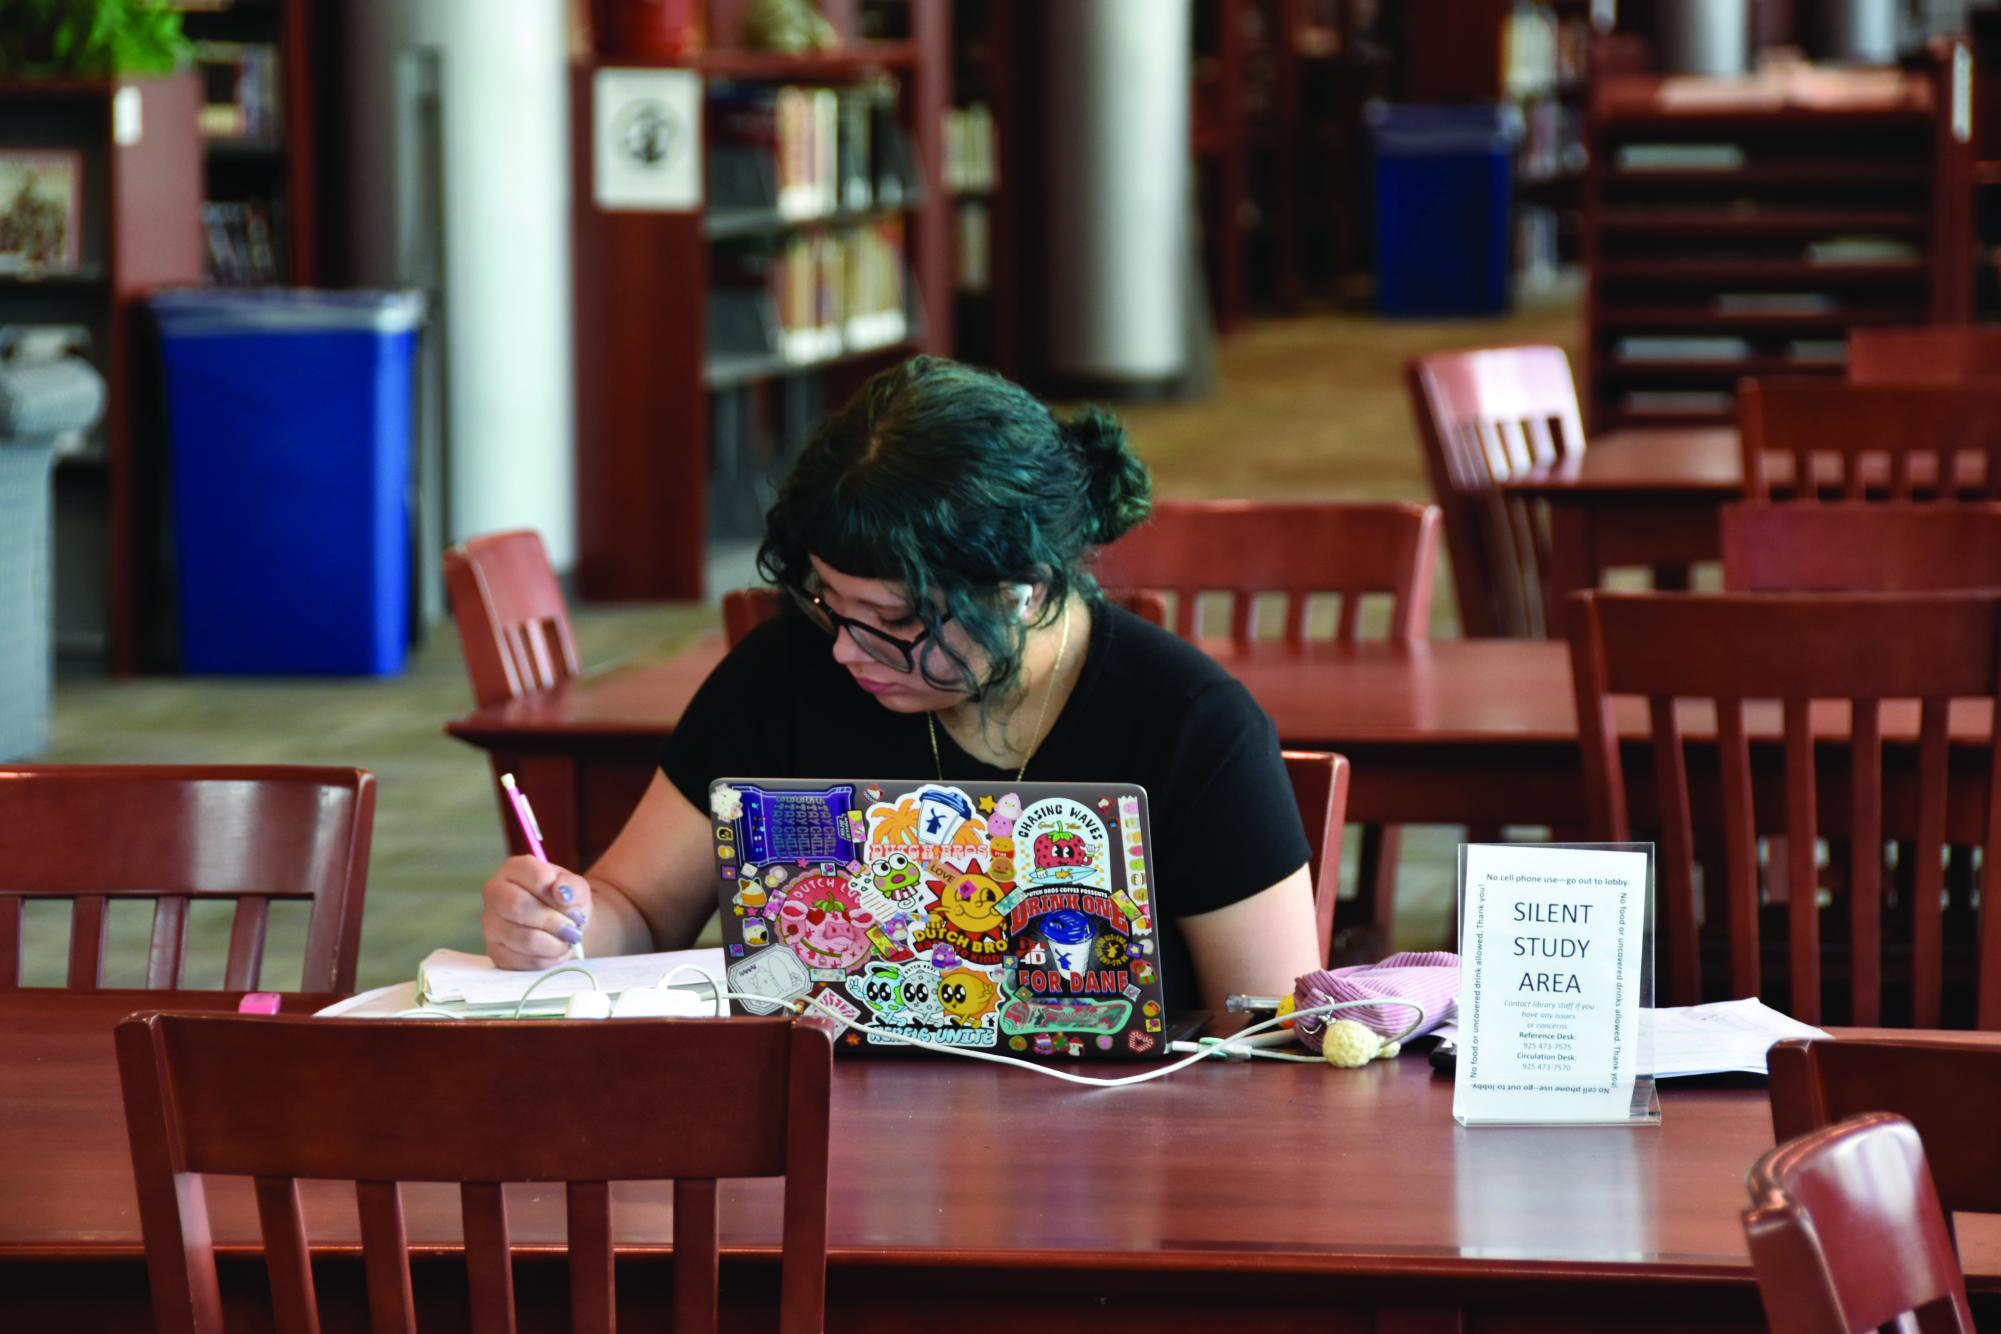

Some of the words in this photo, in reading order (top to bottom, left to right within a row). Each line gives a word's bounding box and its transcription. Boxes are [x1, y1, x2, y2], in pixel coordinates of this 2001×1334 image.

[1018, 804, 1063, 838] CHASING
[1070, 807, 1103, 840] WAVES
[930, 864, 955, 884] LOVE
[1486, 873, 1499, 882] No
[1500, 874, 1514, 882] cell
[1516, 875, 1542, 886] phone
[1578, 877, 1592, 885] out
[1594, 878, 1602, 886] to
[793, 879, 835, 899] DUTCH
[1619, 892, 1628, 904] No
[1010, 893, 1080, 937] DRINK
[1082, 895, 1129, 937] ONE
[1476, 904, 1485, 929] Thank
[1513, 901, 1594, 924] SILENT
[1619, 906, 1627, 926] food
[912, 927, 970, 949] DUTCH
[1618, 926, 1625, 935] or
[1513, 936, 1591, 959] STUDY
[904, 962, 921, 975] DUTCH
[1616, 937, 1624, 981] uncovered
[1019, 970, 1062, 993] FOR
[1474, 967, 1482, 989] drink
[1518, 972, 1582, 994] AREA
[1615, 982, 1623, 1007] drinks
[1473, 990, 1481, 1033] uncovered
[1504, 1000, 1531, 1008] Contact
[1533, 1001, 1556, 1010] library
[1557, 1001, 1574, 1011] staff
[1575, 1002, 1581, 1012] if
[1582, 1003, 1595, 1011] you
[1540, 1012, 1553, 1020] any
[1555, 1012, 1576, 1020] issues
[935, 1027, 996, 1045] UNITE
[1472, 1035, 1479, 1044] or
[1519, 1031, 1555, 1040] Reference
[1556, 1032, 1577, 1041] Desk:
[1471, 1046, 1479, 1065] food
[1516, 1052, 1556, 1061] Circulation
[1557, 1053, 1577, 1061] Desk:
[1612, 1046, 1621, 1070] Thank
[1470, 1067, 1478, 1079] No
[1555, 1086, 1581, 1094] phone
[1582, 1086, 1597, 1094] cell
